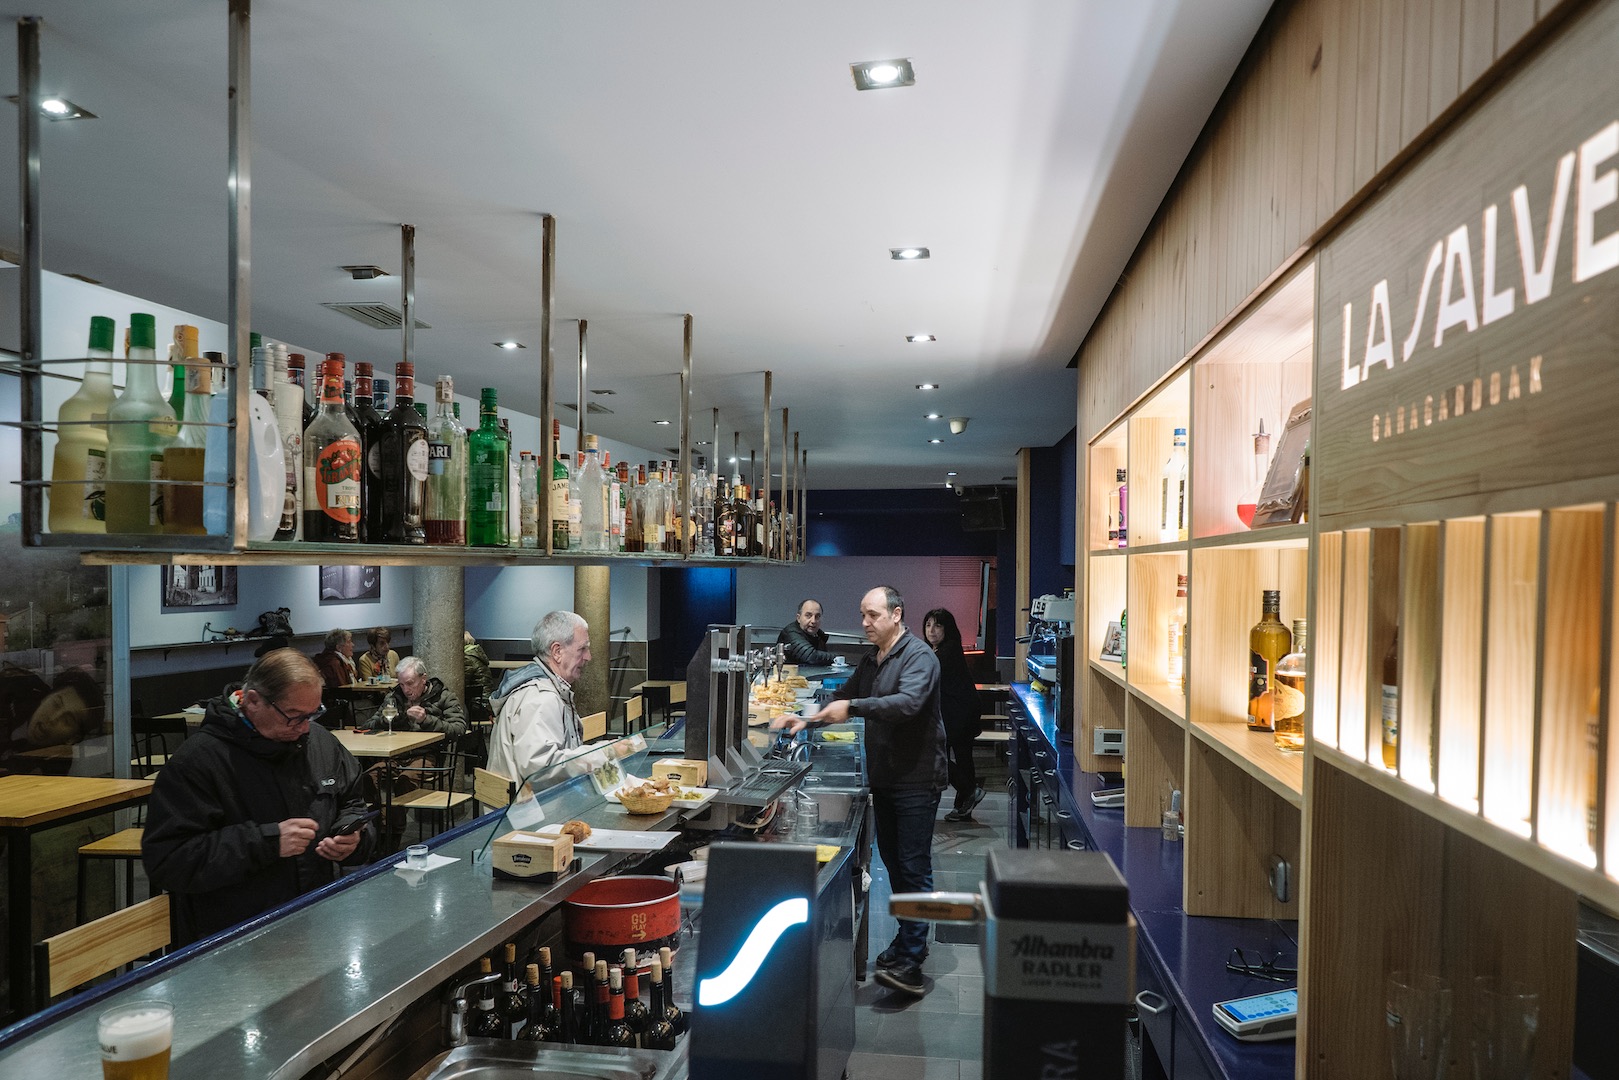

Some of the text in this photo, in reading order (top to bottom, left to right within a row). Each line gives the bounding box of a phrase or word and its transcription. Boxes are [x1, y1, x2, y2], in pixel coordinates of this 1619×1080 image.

[1340, 120, 1619, 391] LA SALVE
[631, 912, 647, 925] GO
[631, 923, 647, 931] PLAY
[1009, 934, 1115, 960] Alhambra
[1021, 960, 1103, 979] RADLER
